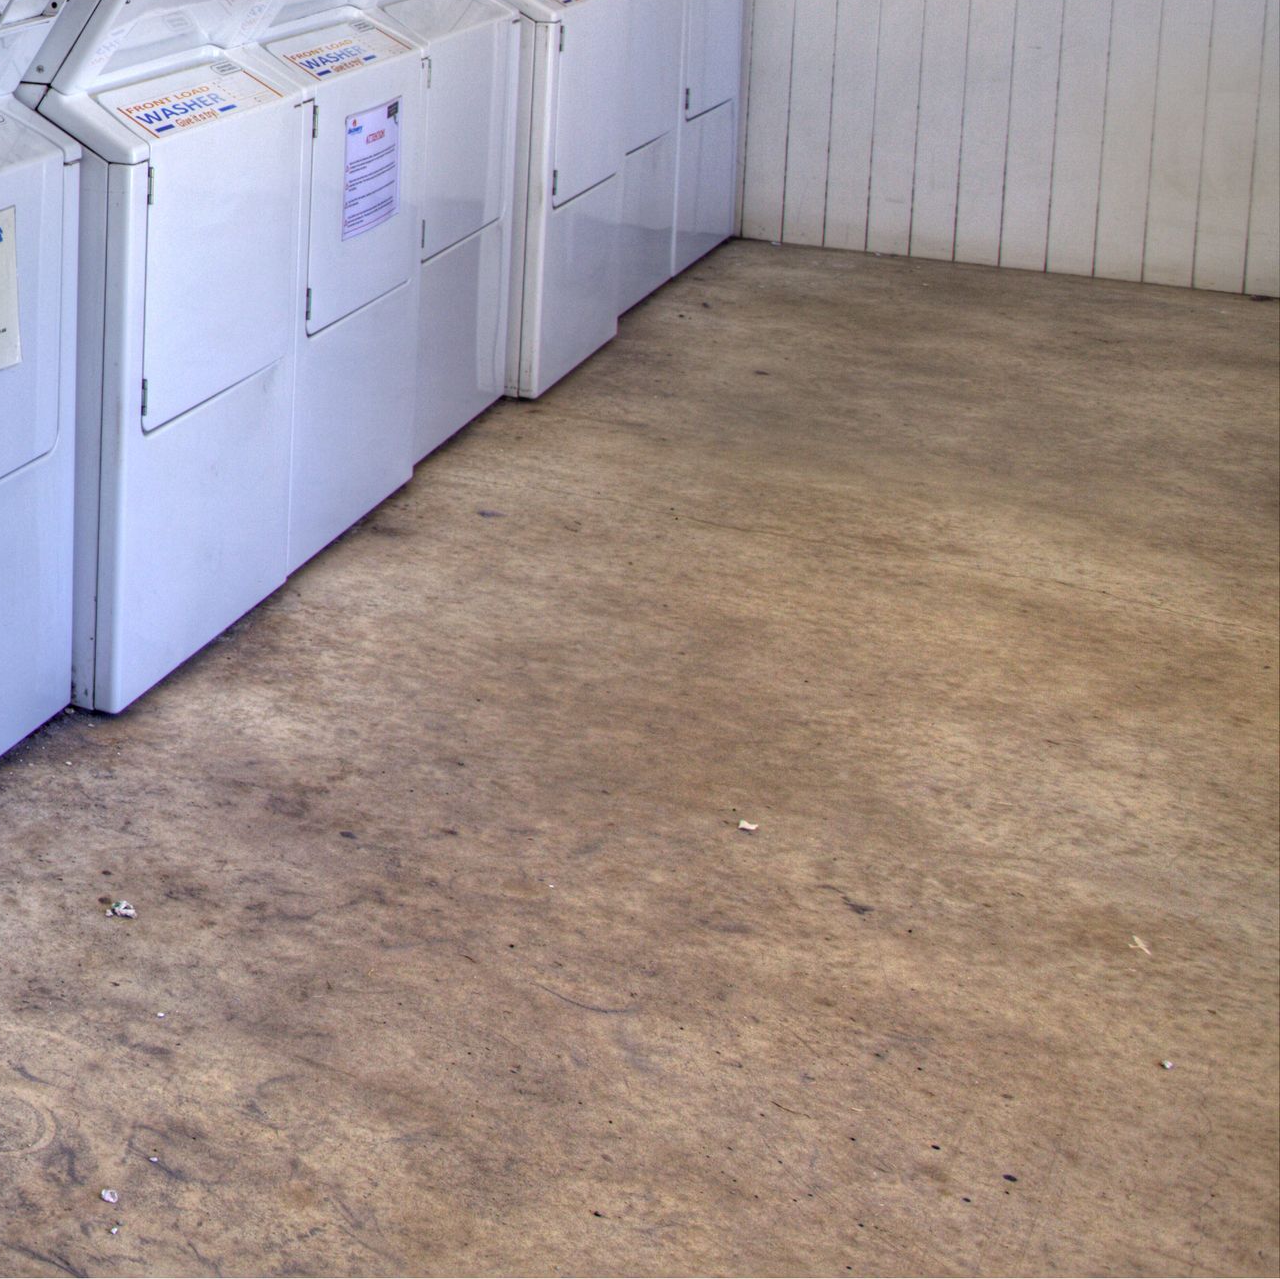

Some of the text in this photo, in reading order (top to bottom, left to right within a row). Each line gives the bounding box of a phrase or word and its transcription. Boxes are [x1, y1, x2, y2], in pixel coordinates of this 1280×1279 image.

[299, 45, 366, 70] WASHER
[125, 85, 210, 114] FRONT LOAD
[135, 92, 226, 125] WASHER
